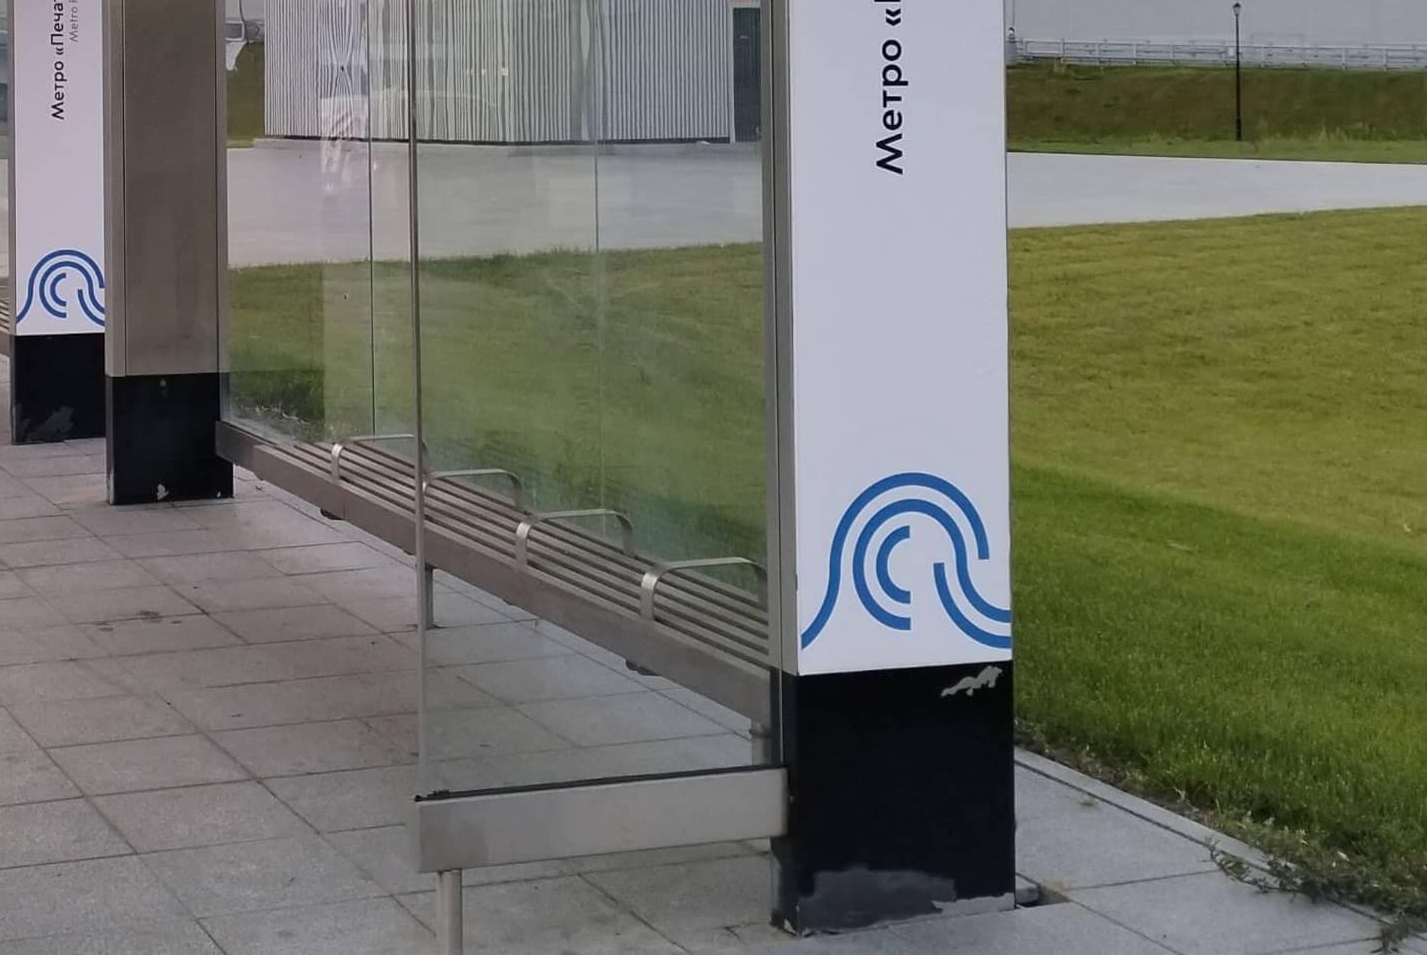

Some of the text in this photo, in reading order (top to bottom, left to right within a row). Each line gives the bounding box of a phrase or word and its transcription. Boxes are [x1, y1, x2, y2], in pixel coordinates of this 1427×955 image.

[68, 7, 79, 43] Metro
[51, 60, 68, 120] Метро
[875, 39, 909, 175] Метро
